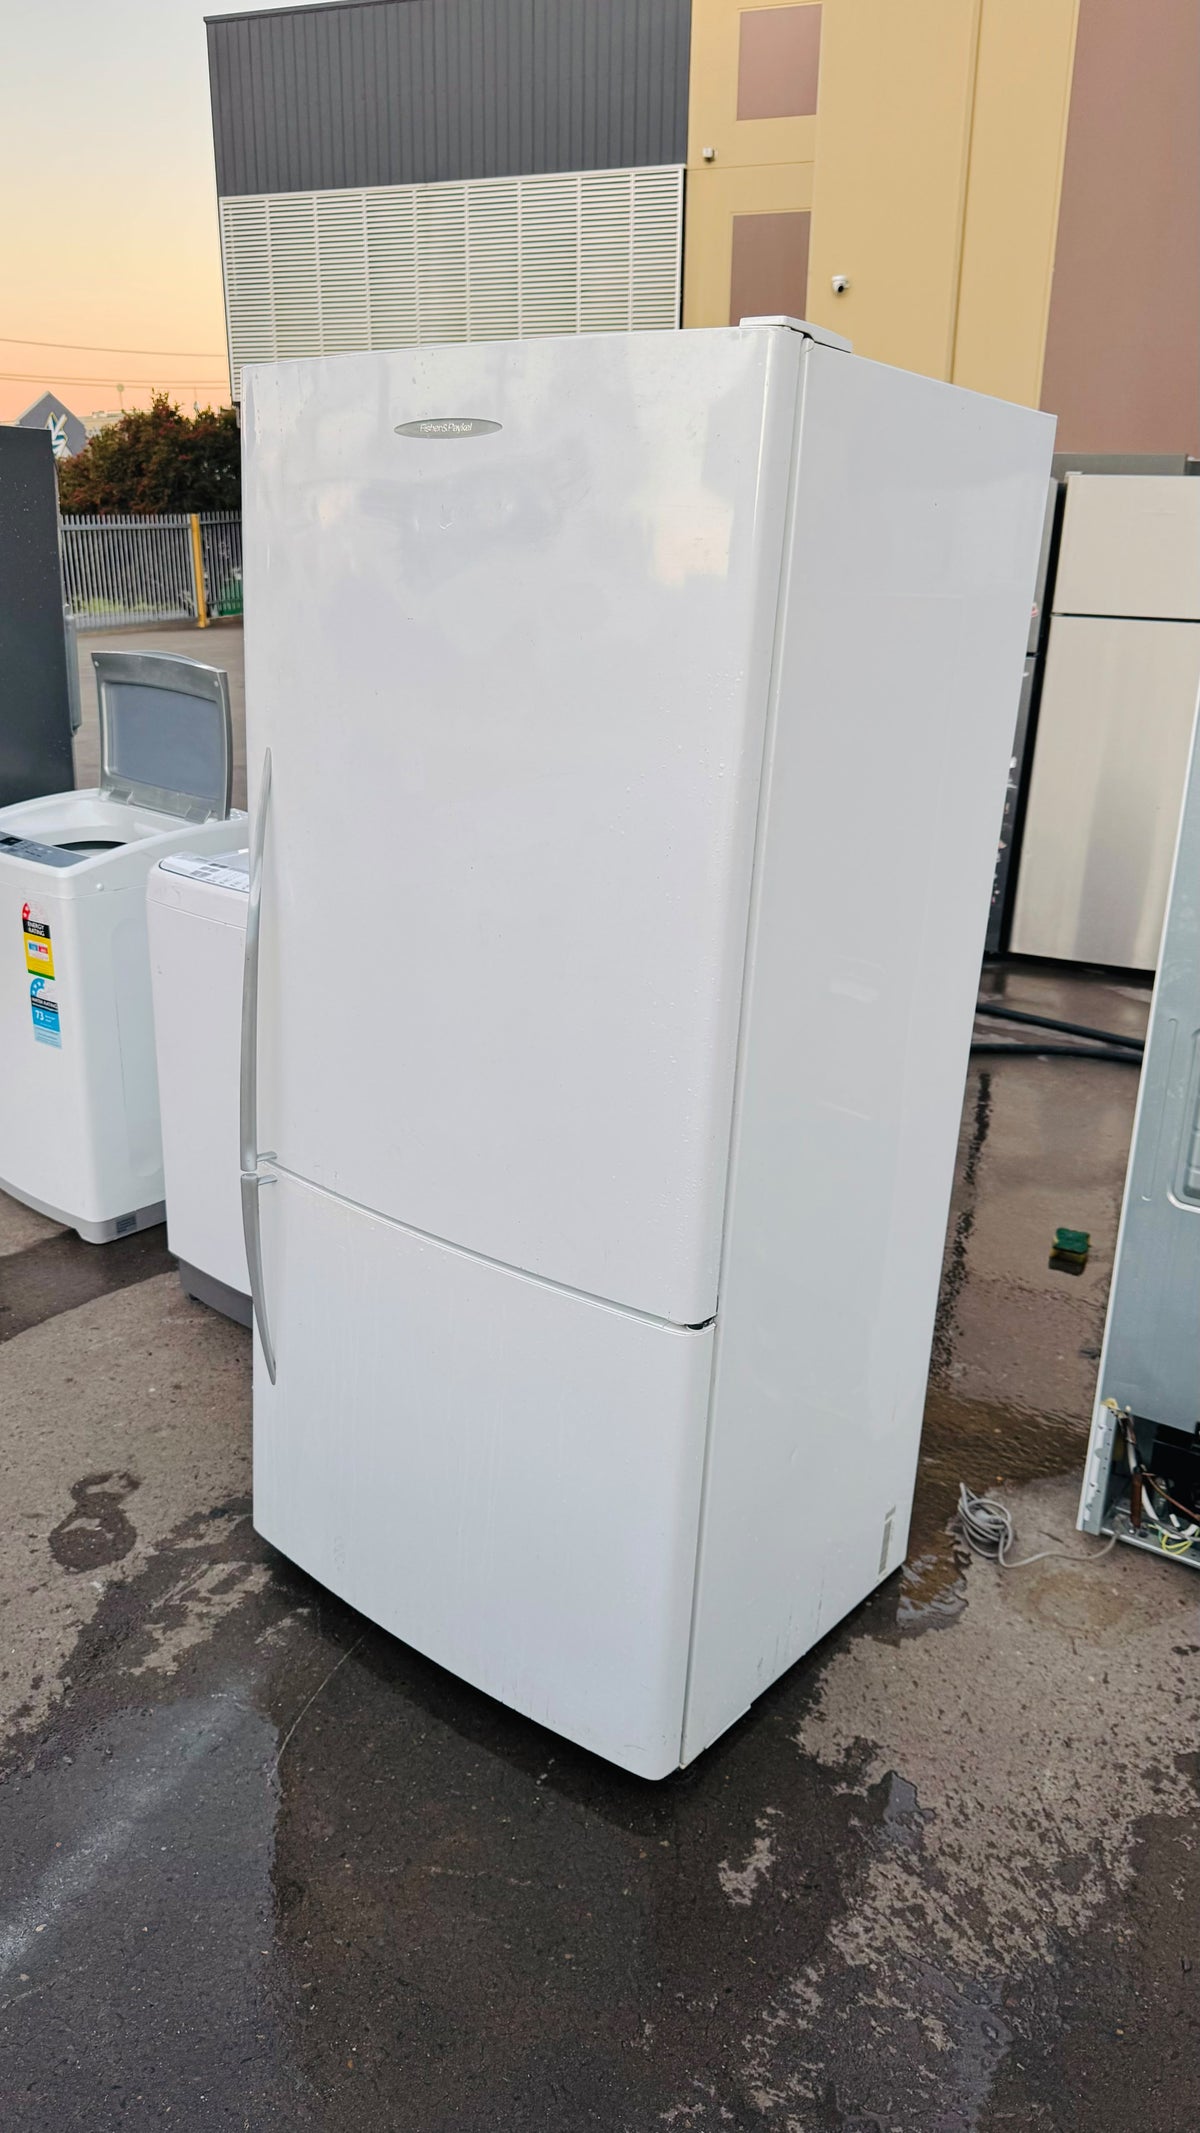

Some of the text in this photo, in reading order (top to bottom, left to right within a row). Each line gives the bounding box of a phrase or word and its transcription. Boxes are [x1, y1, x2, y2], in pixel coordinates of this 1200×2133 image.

[27, 920, 45, 930] ENERGY
[28, 927, 45, 936] RATING
[35, 1010, 44, 1020] 73
